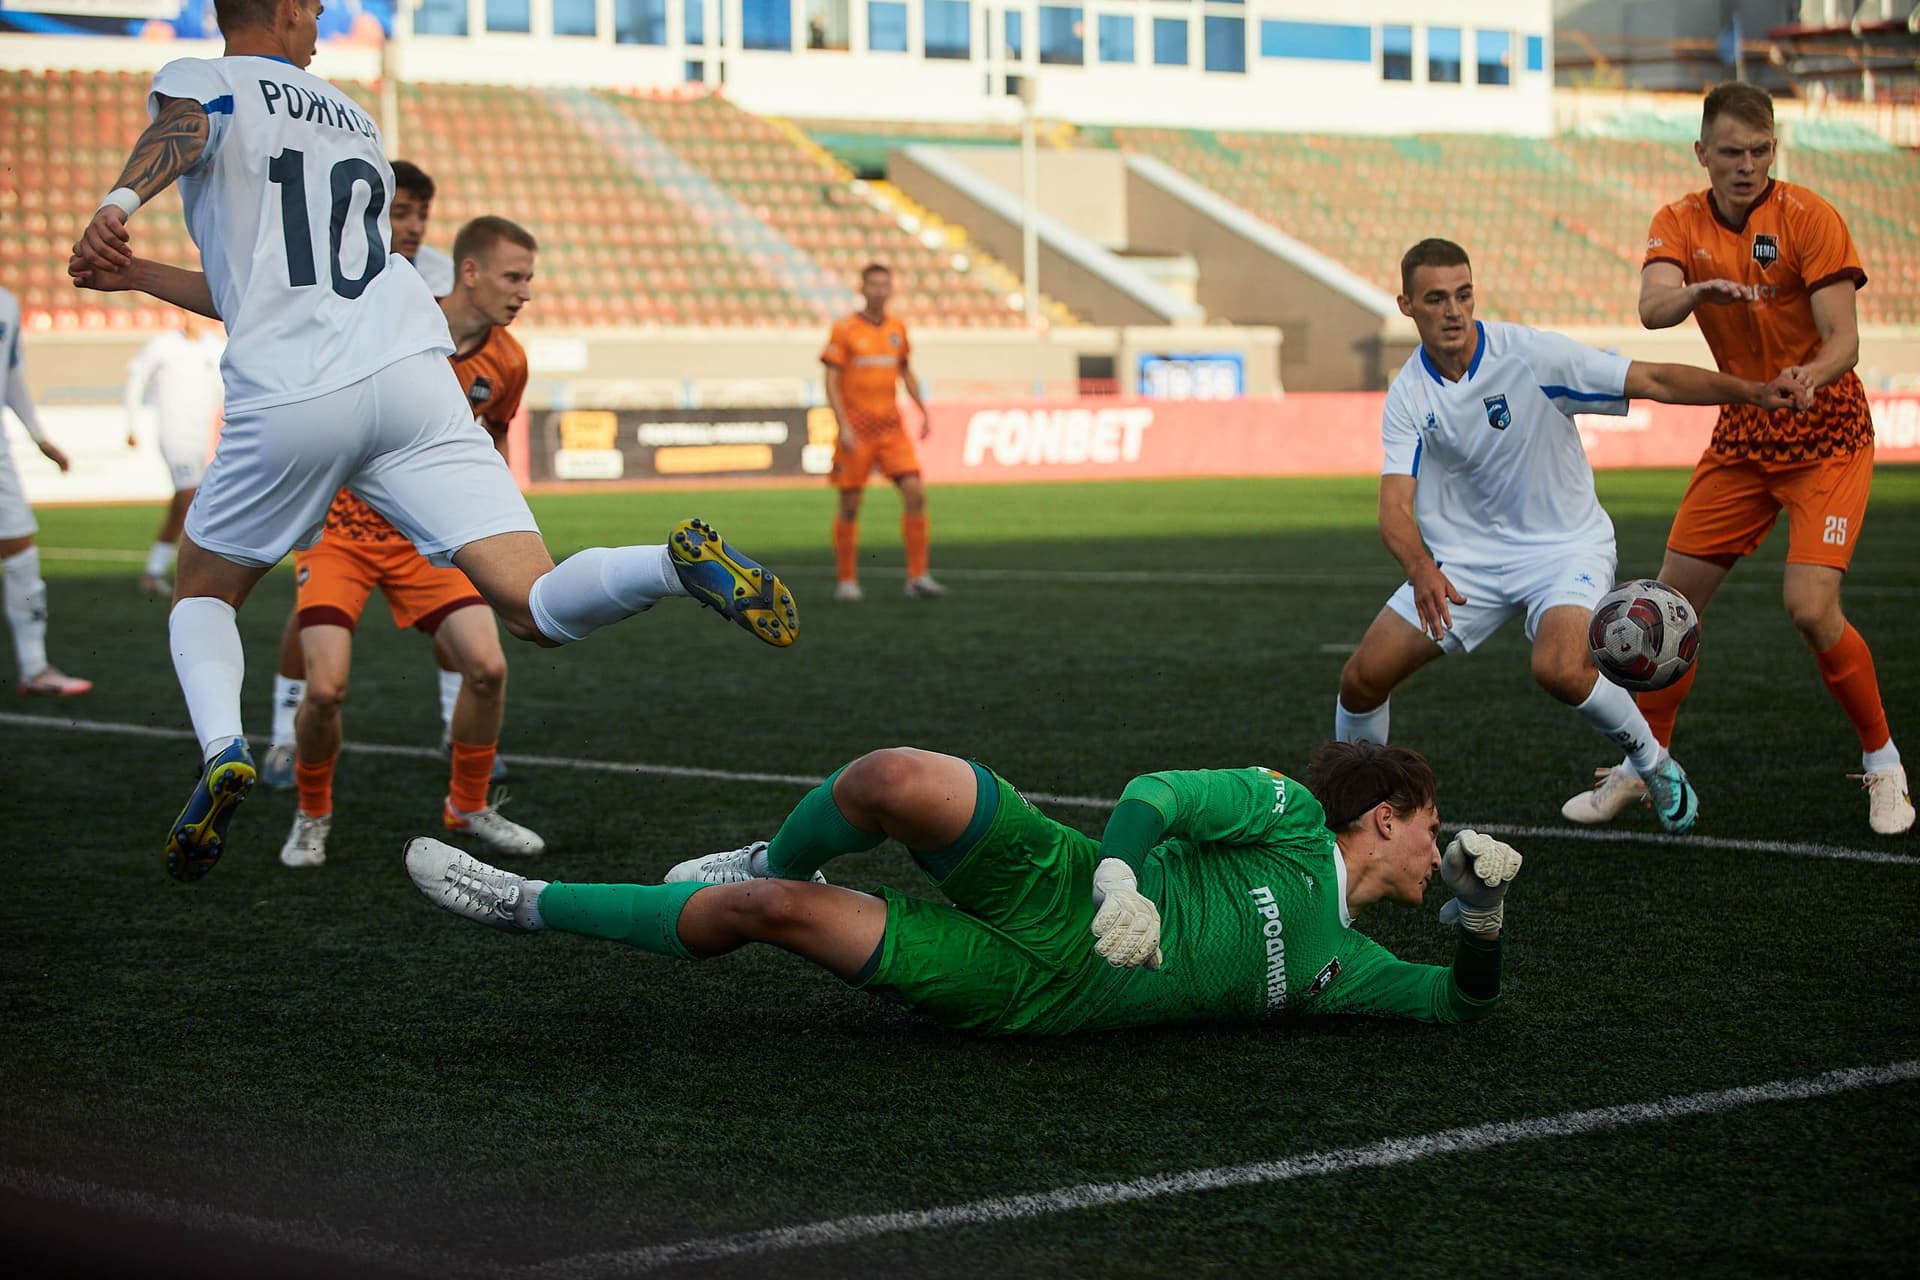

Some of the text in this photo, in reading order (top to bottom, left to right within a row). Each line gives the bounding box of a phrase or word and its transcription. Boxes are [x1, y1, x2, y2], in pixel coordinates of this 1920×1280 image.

[269, 147, 386, 300] 10
[963, 407, 1154, 466] FONBET
[1823, 515, 1848, 546] 25
